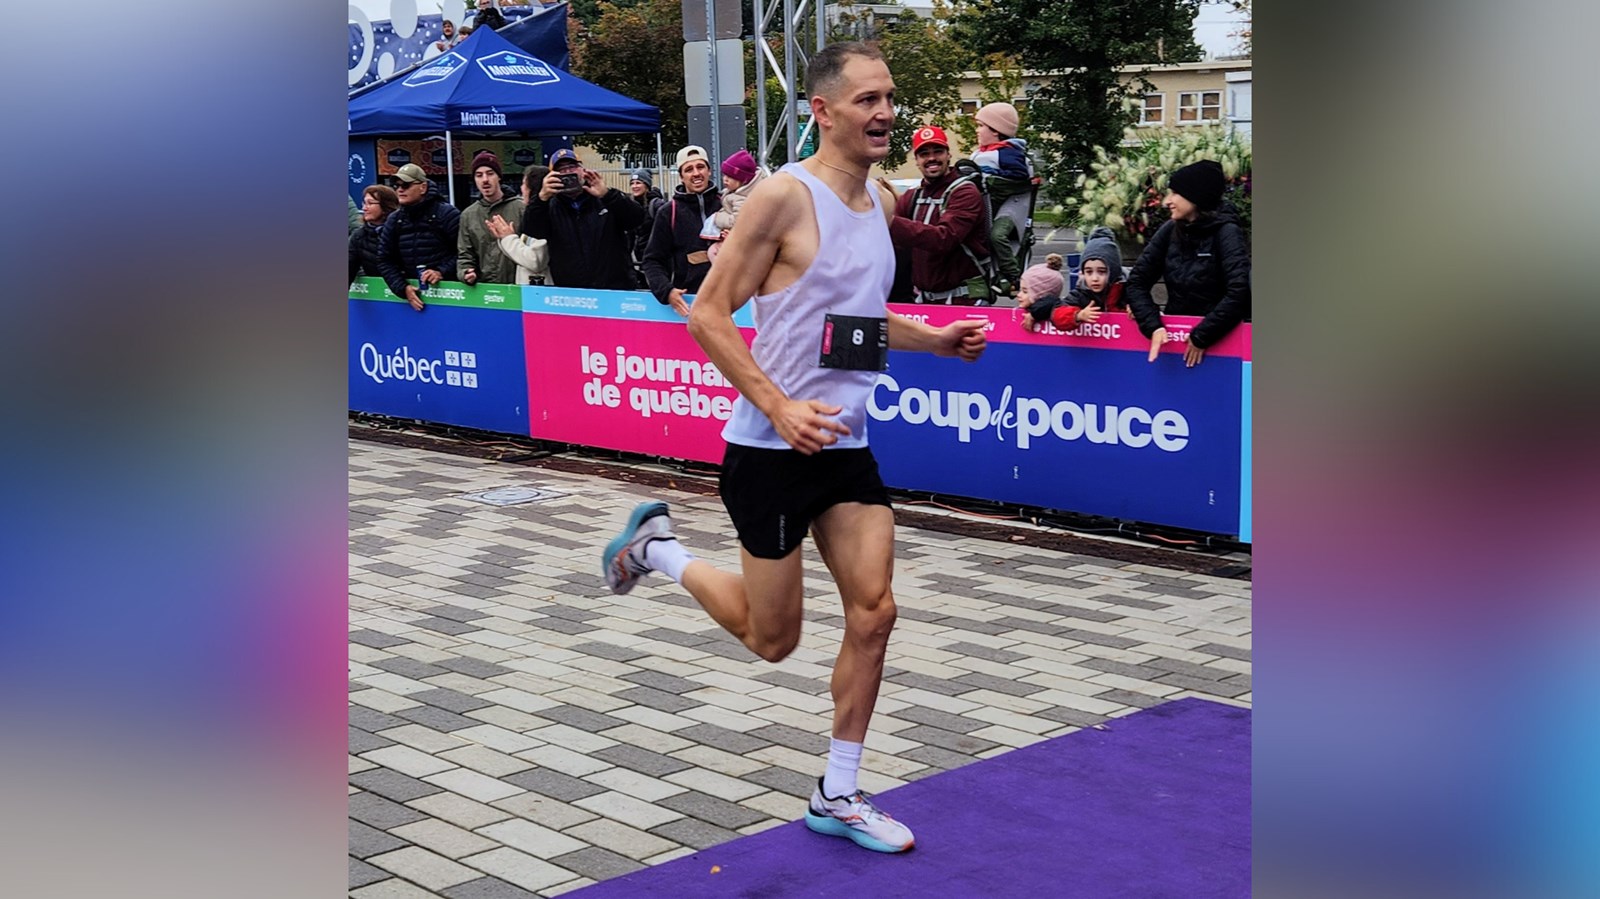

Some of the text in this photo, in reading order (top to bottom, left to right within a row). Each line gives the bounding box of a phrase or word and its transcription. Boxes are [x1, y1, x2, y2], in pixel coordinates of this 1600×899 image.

[460, 110, 506, 126] MONTELLIER
[544, 295, 598, 310] #JECOURSQC
[851, 328, 865, 346] 8
[360, 342, 444, 385] Québec
[580, 345, 609, 376] le
[583, 377, 733, 421] de québe
[865, 373, 992, 443] Coup
[1015, 396, 1190, 452] pouce
